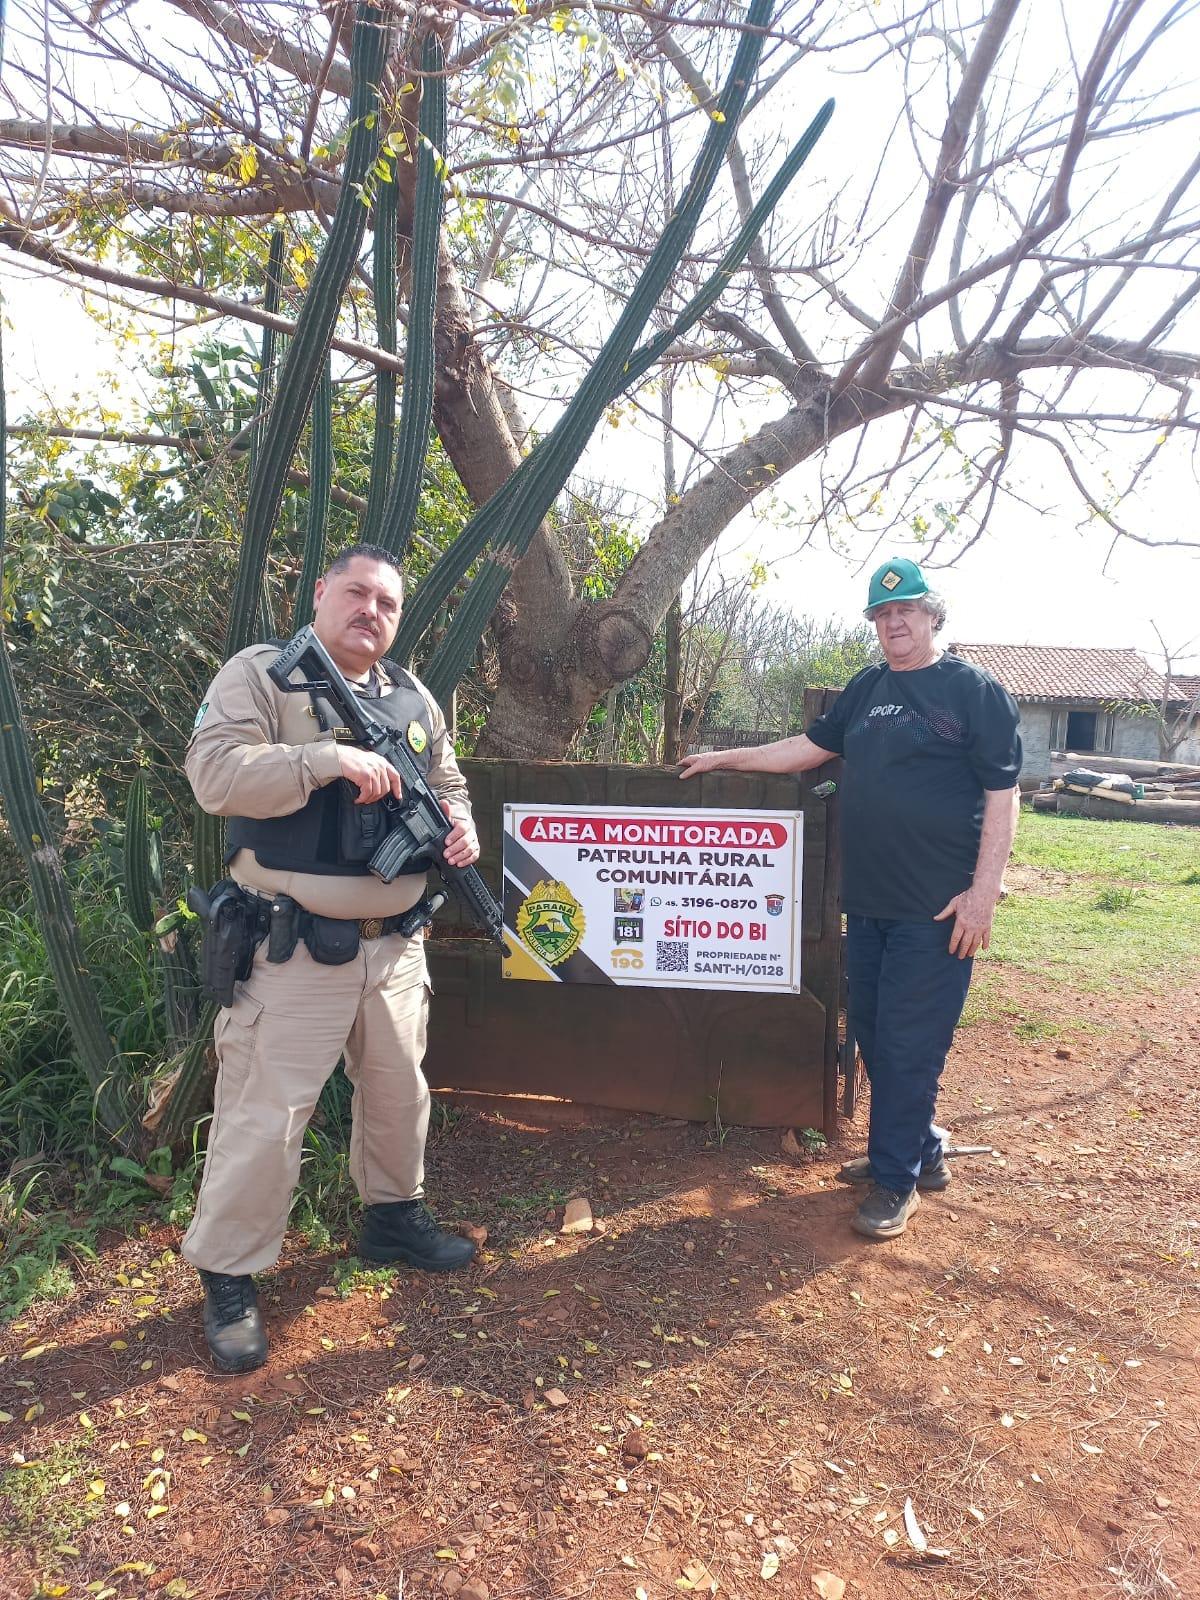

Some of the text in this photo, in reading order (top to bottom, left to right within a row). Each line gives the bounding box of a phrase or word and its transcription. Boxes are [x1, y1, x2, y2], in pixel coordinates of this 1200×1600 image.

[869, 704, 903, 717] SPORT
[530, 818, 777, 846] ÁREA MONITORADA
[577, 848, 775, 868] PATRULHA RURAL
[596, 868, 753, 887] COMUNITÁRIA
[529, 903, 574, 914] PARANÁ
[681, 897, 758, 909] 3196-0870
[617, 926, 641, 938] 181
[664, 915, 767, 941] SÍTIO DO BI
[554, 933, 576, 957] MILITAR
[611, 957, 644, 969] 190
[696, 951, 767, 961] PROPRIEDADE
[694, 962, 784, 977] SANT-H/0128
